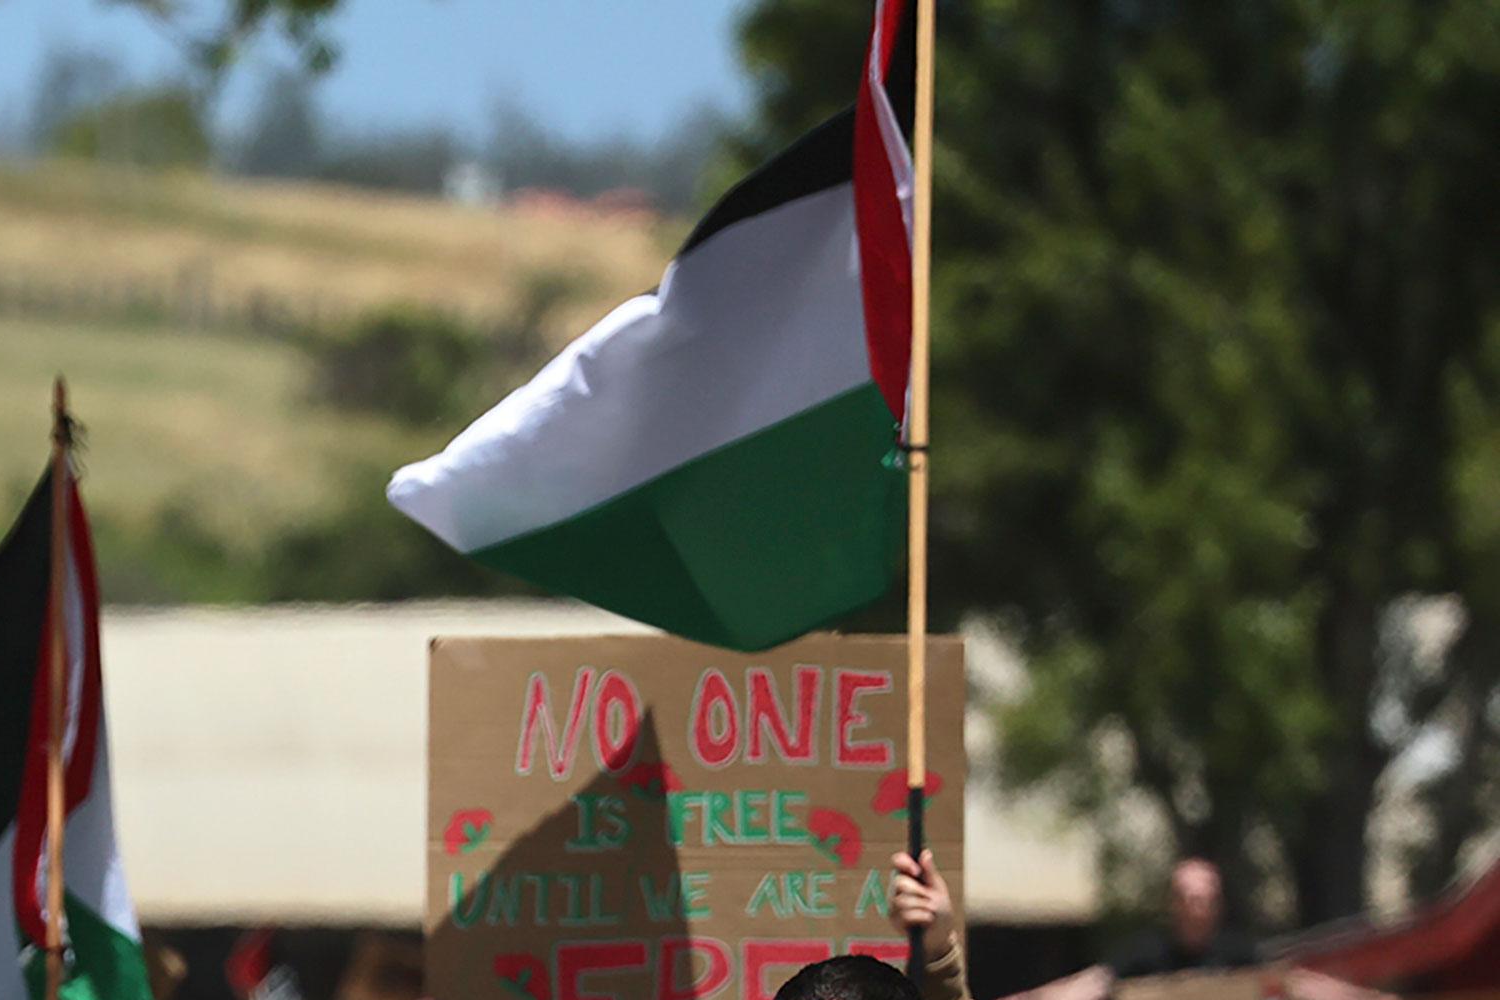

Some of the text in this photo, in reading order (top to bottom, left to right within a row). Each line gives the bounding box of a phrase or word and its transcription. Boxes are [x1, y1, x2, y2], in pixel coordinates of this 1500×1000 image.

[515, 663, 893, 780] NO ONE
[566, 790, 814, 852] IS FREE
[450, 872, 620, 929] UNTIL
[639, 873, 711, 922] WE
[746, 871, 837, 920] ARE
